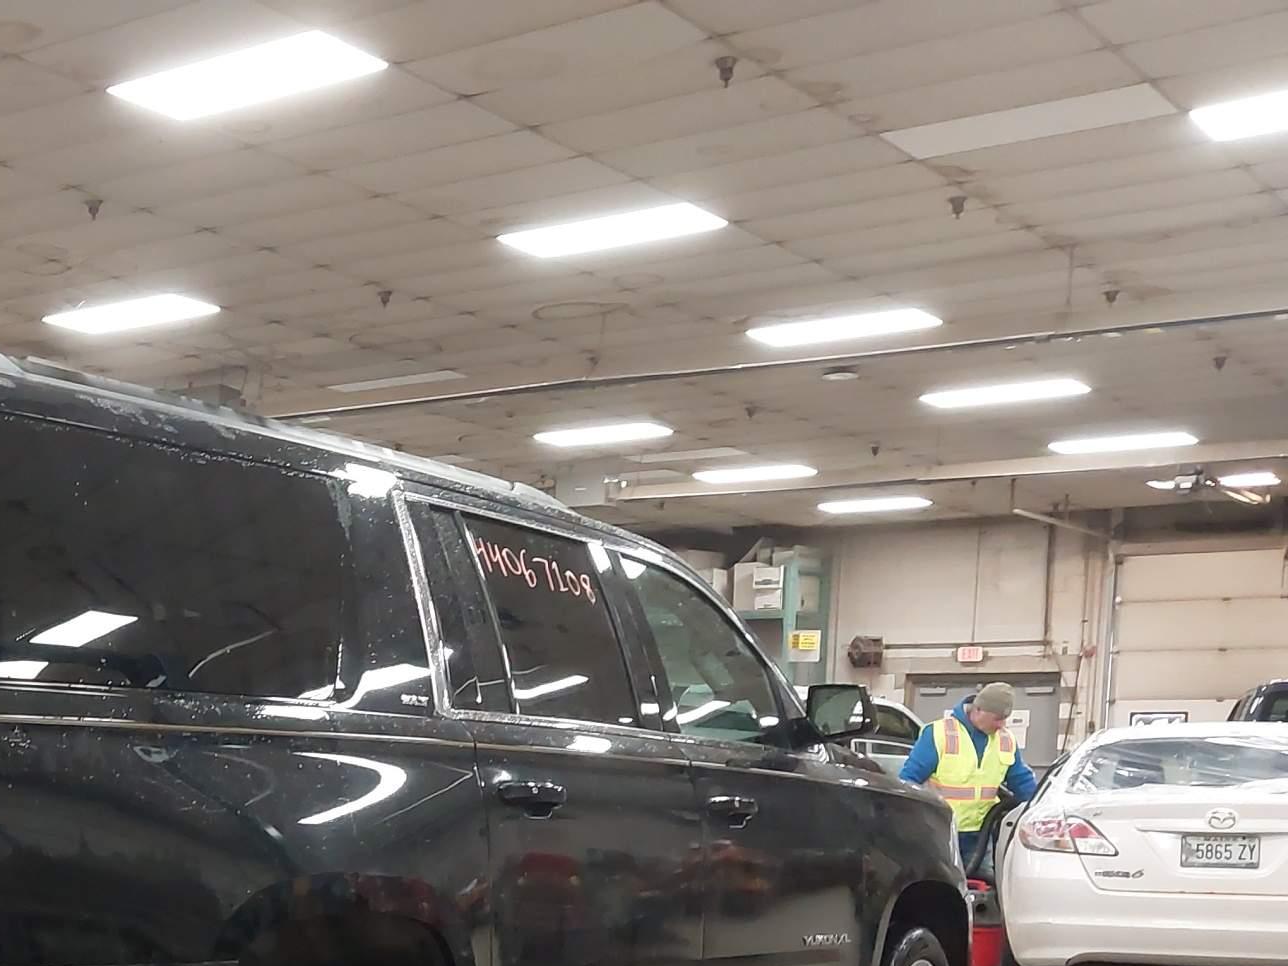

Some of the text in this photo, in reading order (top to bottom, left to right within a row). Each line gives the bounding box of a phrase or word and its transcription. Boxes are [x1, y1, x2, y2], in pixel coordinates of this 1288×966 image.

[473, 537, 596, 606] 44067108
[1196, 843, 1256, 861] 5865 ZY
